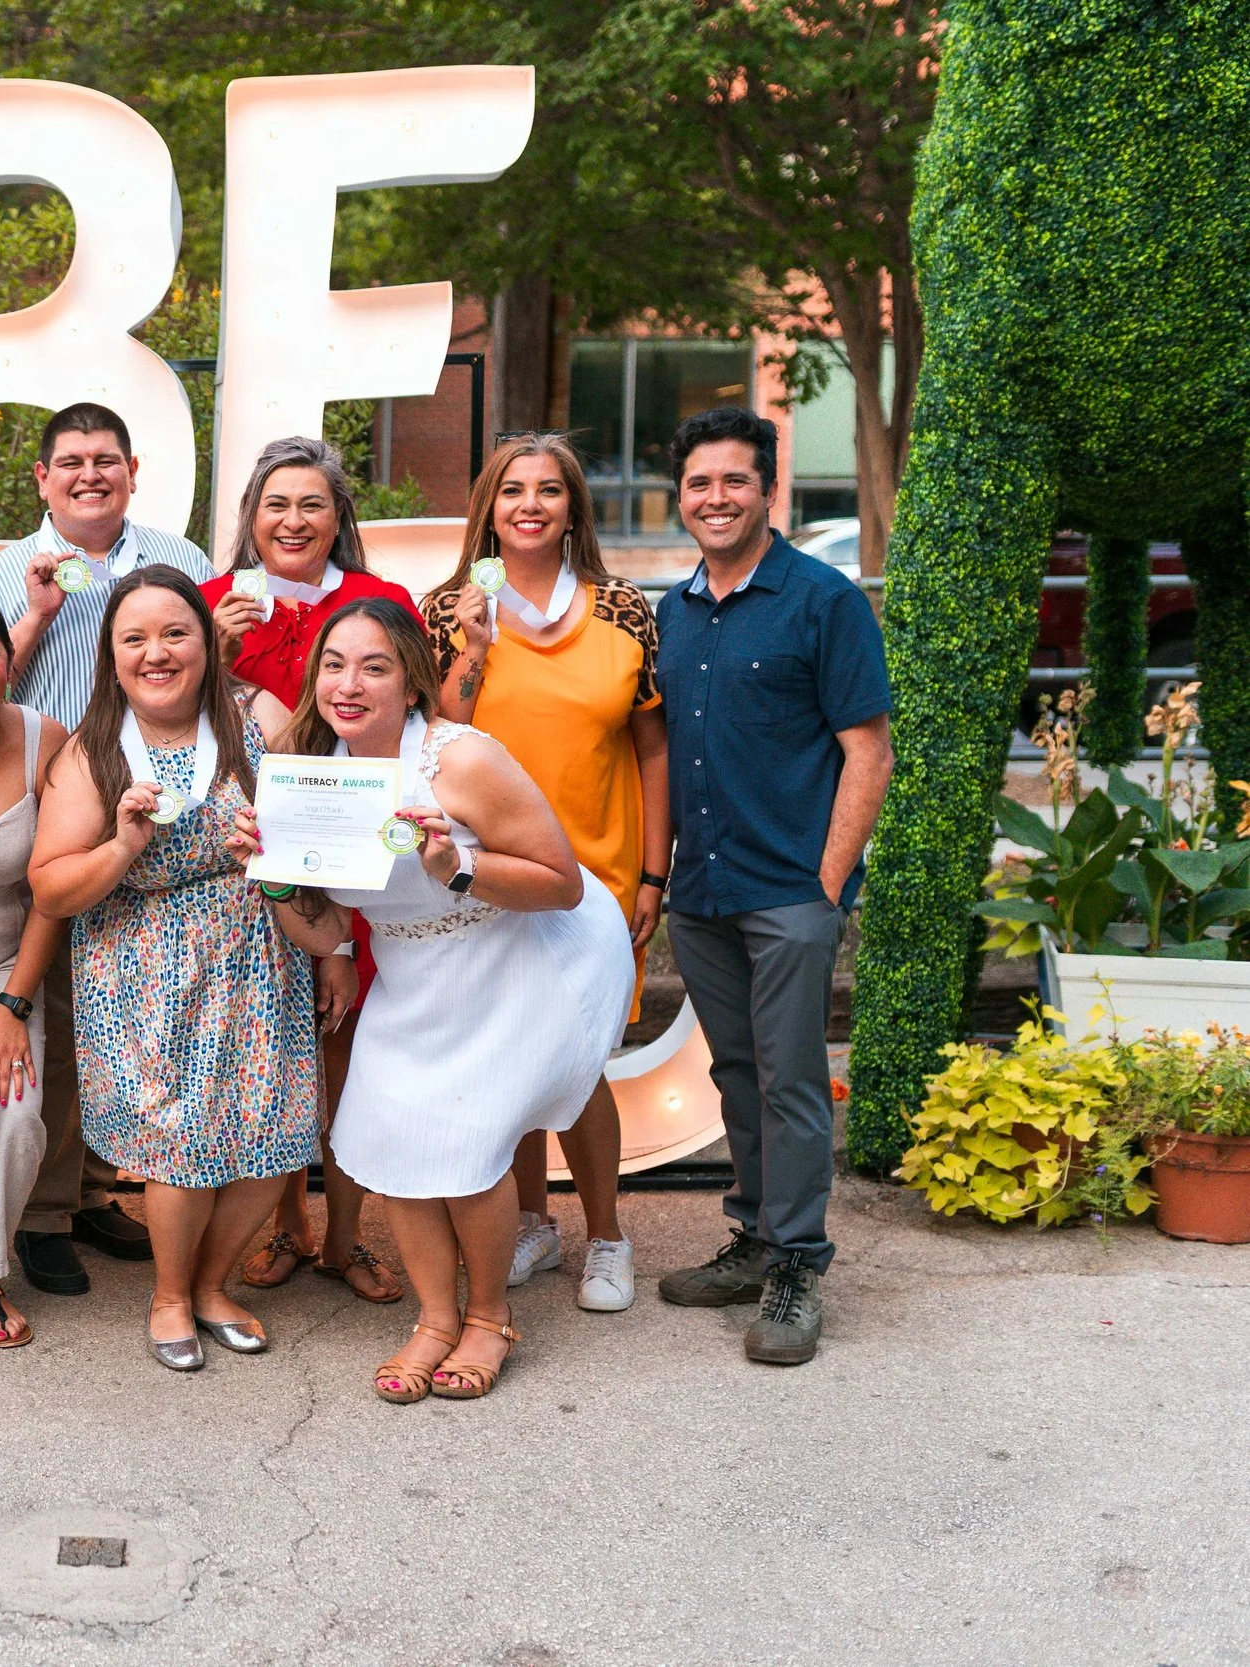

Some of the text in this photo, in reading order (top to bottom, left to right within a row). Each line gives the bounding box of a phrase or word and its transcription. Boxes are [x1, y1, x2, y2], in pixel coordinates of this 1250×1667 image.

[270, 775, 385, 788] FIESTA LITERACY AWARDS
